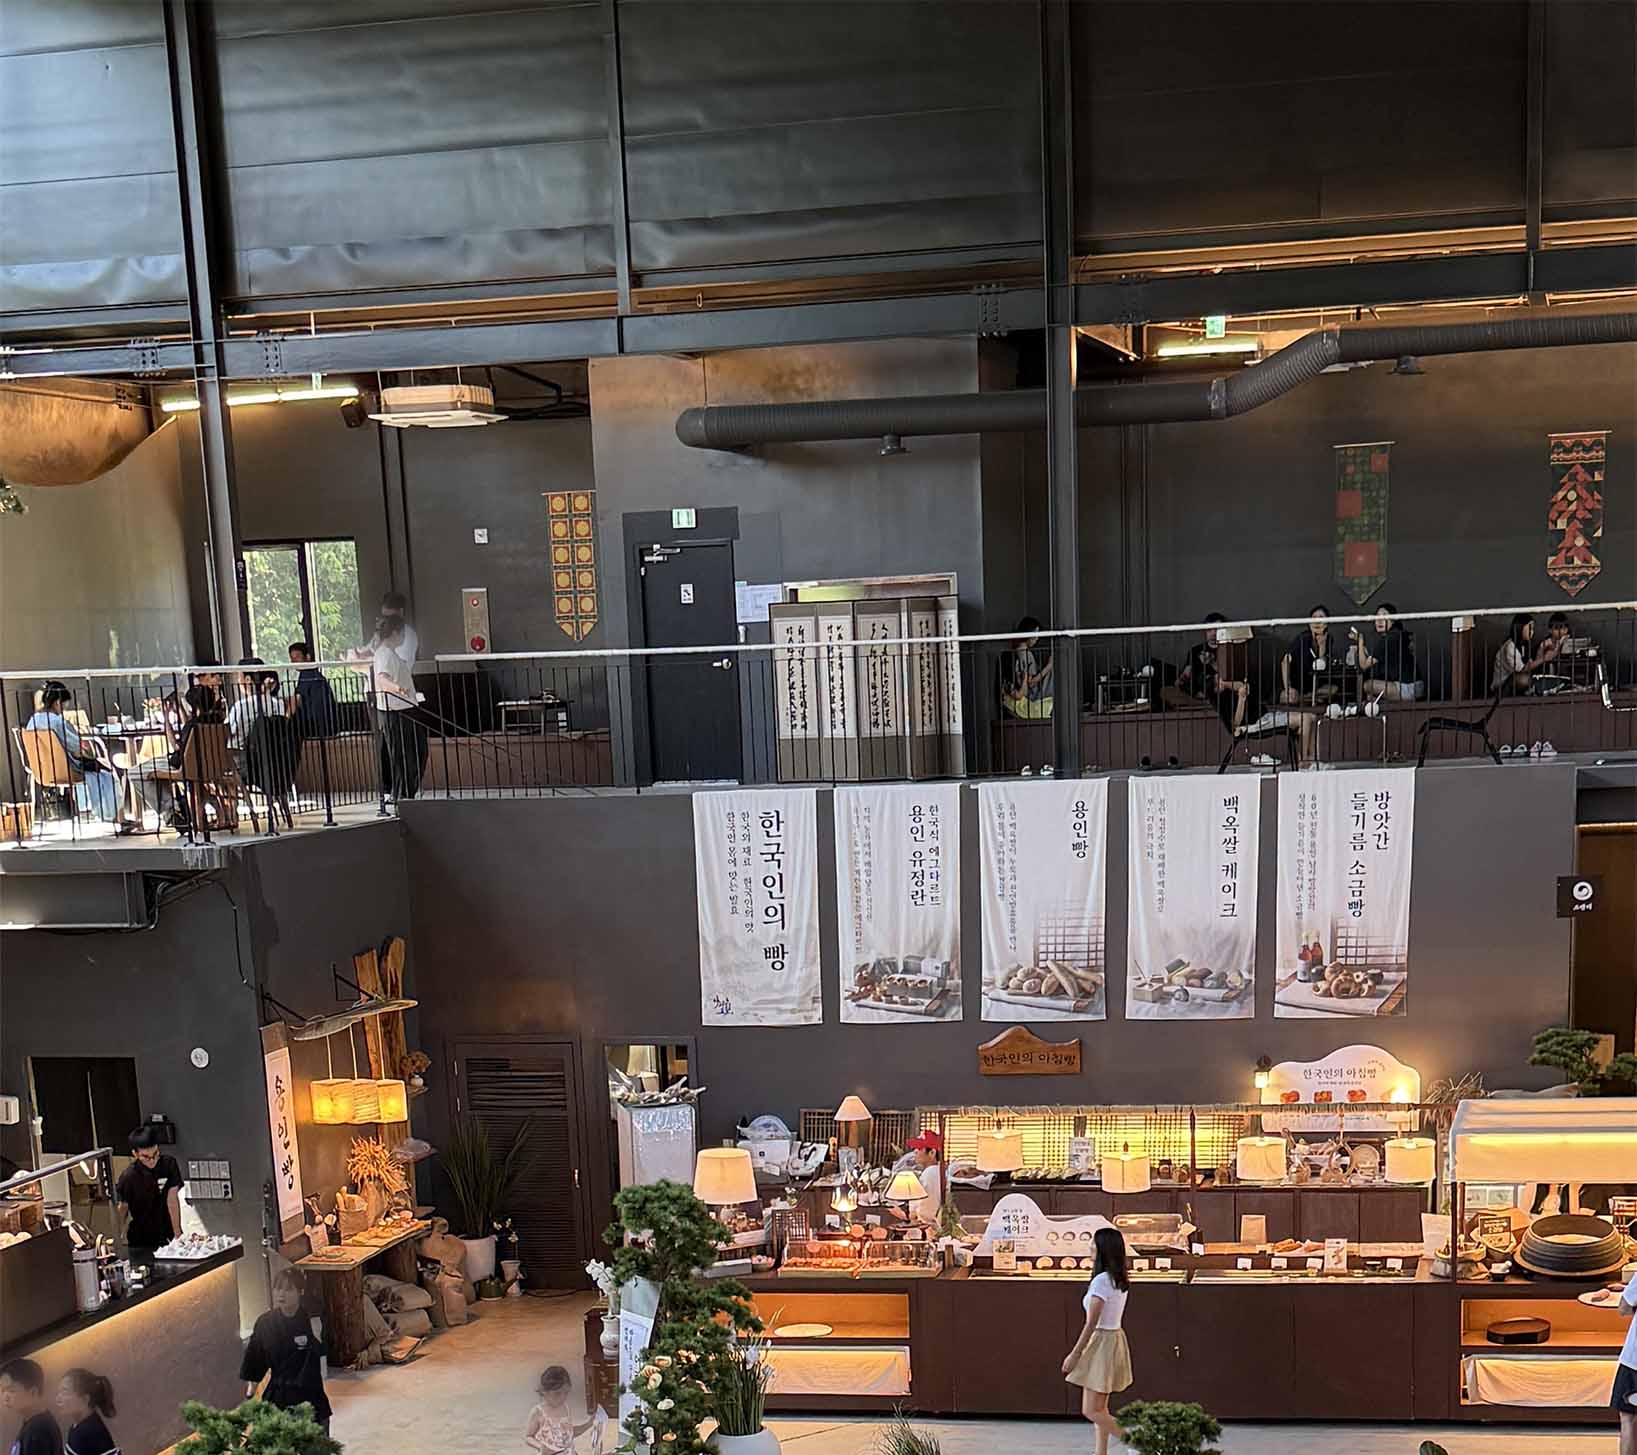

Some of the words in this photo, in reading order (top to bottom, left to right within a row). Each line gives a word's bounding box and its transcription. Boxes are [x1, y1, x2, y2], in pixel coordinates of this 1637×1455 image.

[909, 805, 925, 842] 용인
[929, 804, 939, 841] 한국식
[1072, 800, 1088, 859] 용인빵
[1221, 795, 1240, 854] 백옥쌀
[1349, 792, 1368, 851] 들기름
[1371, 791, 1392, 850] 방앗간
[759, 810, 785, 930] 한국인의
[909, 850, 926, 906] 유정란
[929, 846, 941, 906] 에그타르트
[1220, 862, 1238, 917] 케이크
[1347, 860, 1367, 917] 소금빵
[764, 943, 789, 971] 빵
[984, 1052, 1033, 1066] 한국인의
[1303, 1067, 1343, 1079] 한국인의
